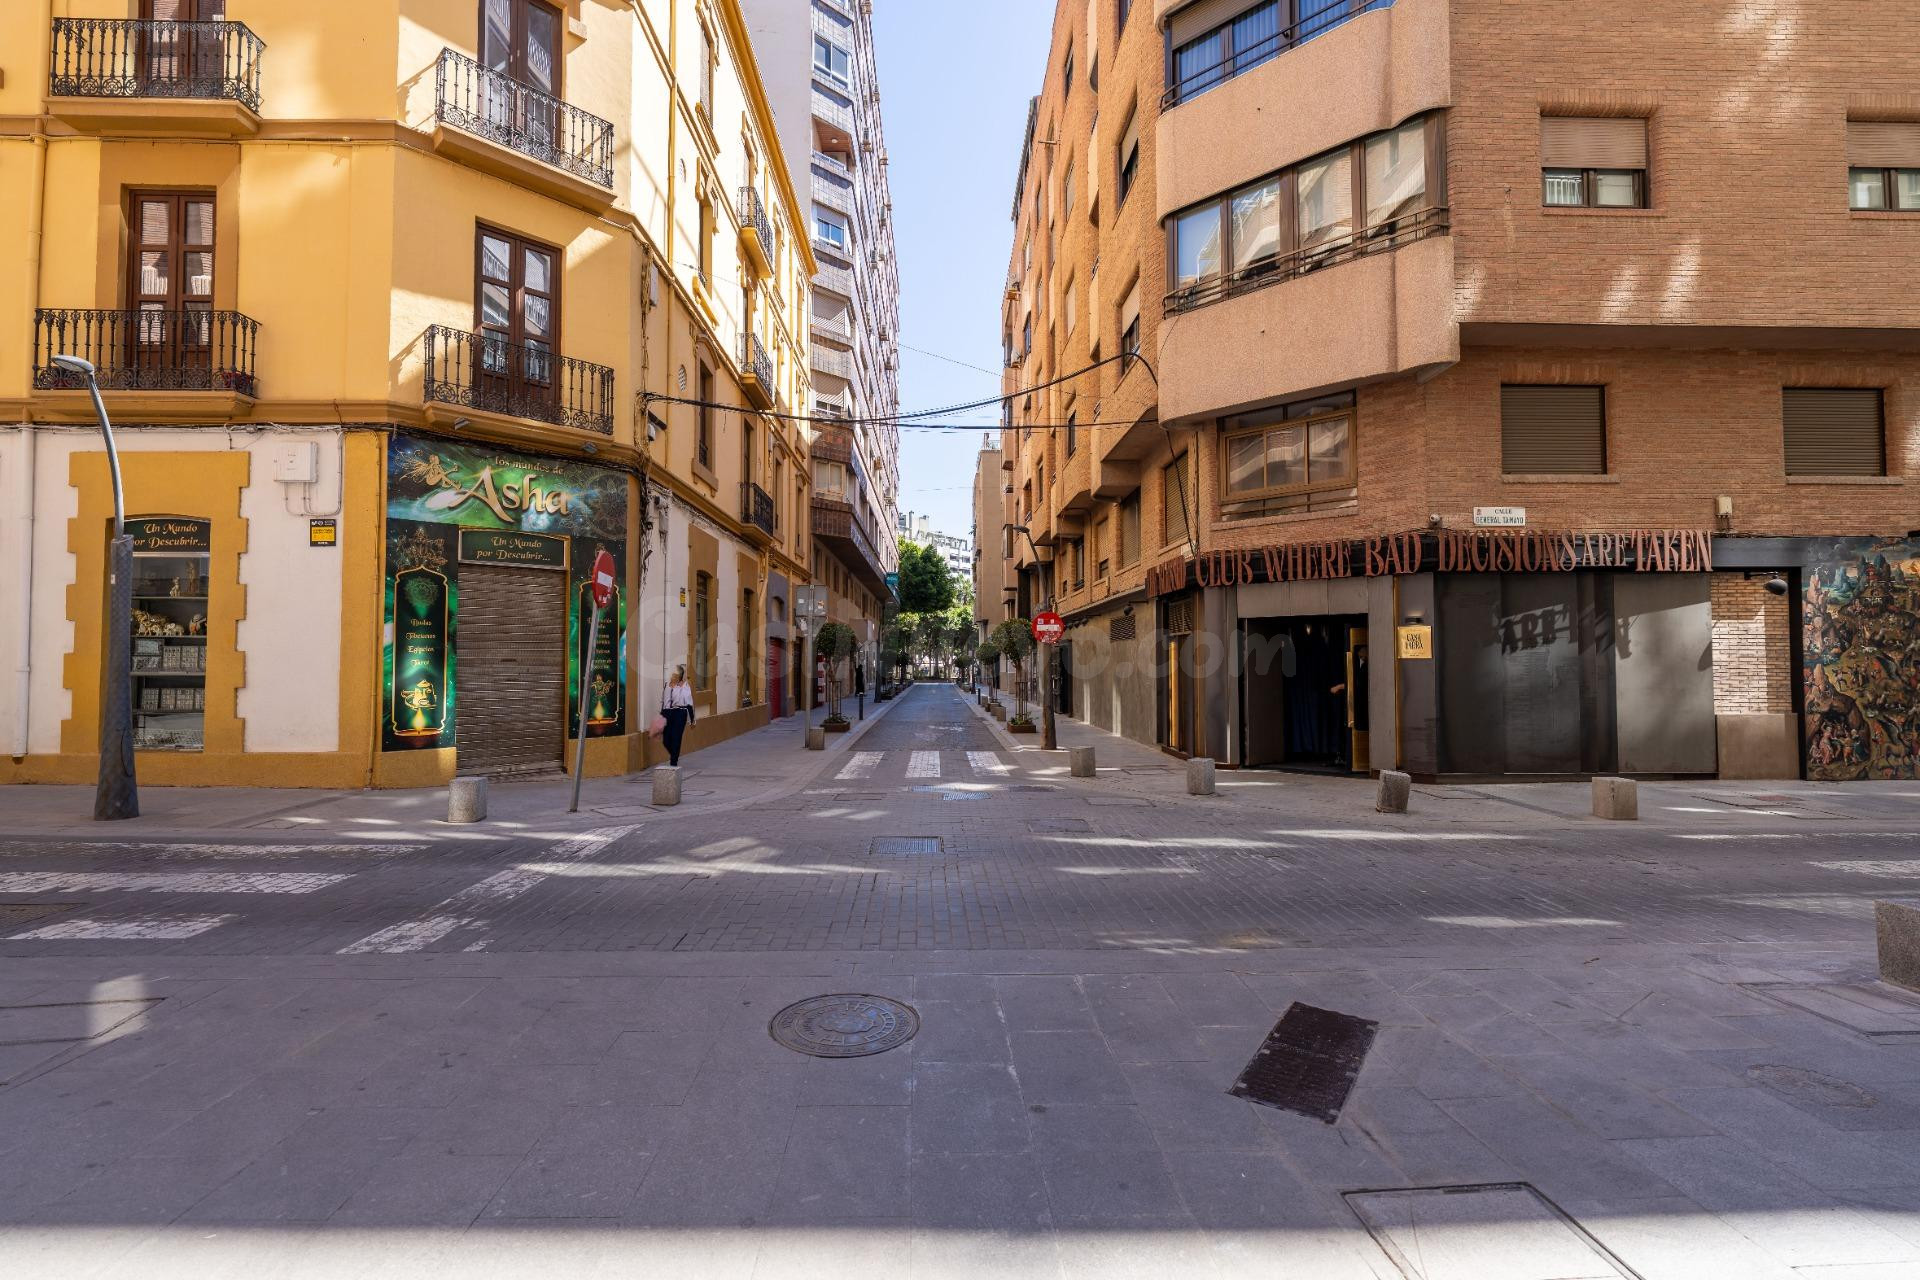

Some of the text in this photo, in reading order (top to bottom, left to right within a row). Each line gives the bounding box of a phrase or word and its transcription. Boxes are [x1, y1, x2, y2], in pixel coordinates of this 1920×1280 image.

[512, 461, 550, 473] mundos
[552, 466, 564, 475] de
[448, 465, 570, 524] Asha
[1476, 516, 1524, 524] GENERAL TAMAYO
[143, 523, 198, 535] Un Mundo
[491, 536, 542, 549] Un Mundo
[476, 550, 492, 559] por
[1195, 545, 1254, 587] CLUB
[1263, 539, 1352, 582] WHERE
[1364, 531, 1422, 576] BAD
[1437, 529, 1577, 572] DECISIONS
[1582, 533, 1627, 567] ARE
[1631, 529, 1713, 572] TAKEN
